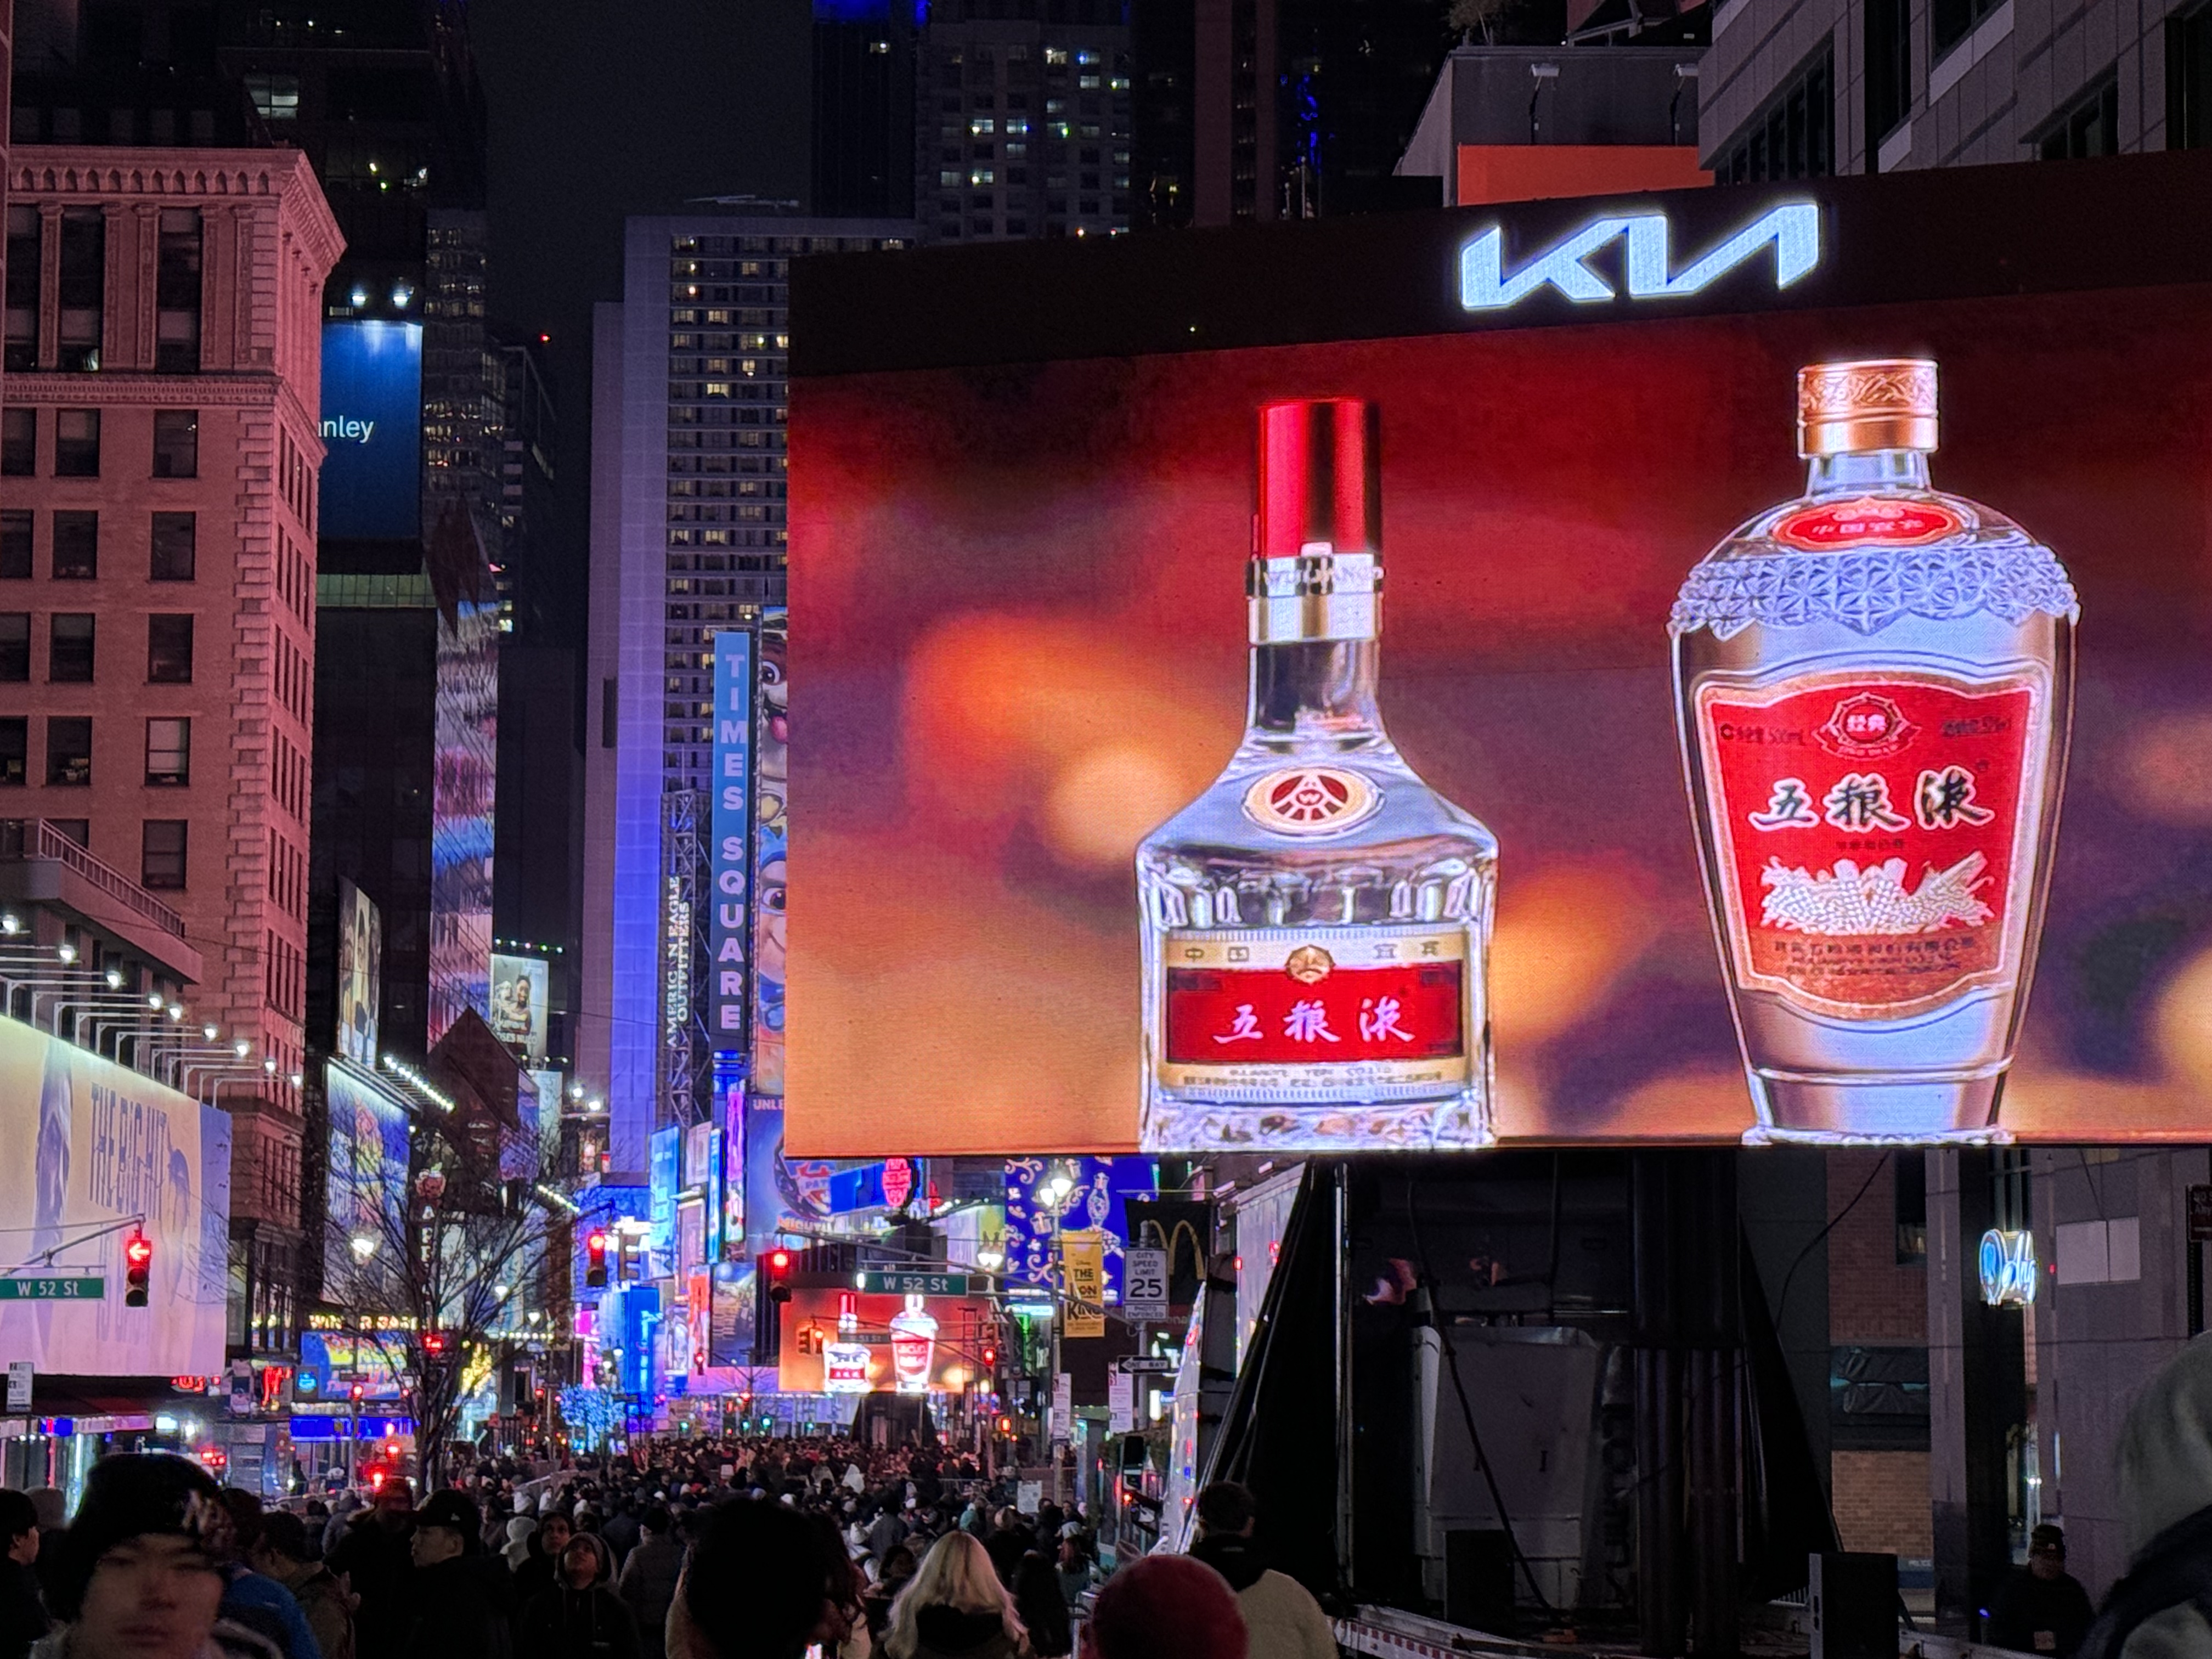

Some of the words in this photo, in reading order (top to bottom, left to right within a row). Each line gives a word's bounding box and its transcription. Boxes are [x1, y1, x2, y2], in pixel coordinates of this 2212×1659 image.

[1462, 204, 1819, 309] KIA
[719, 654, 747, 811] TIMES
[1748, 766, 1995, 831] 五粮液
[668, 876, 680, 938] EAGLE
[718, 835, 747, 1030] SQUARE
[677, 901, 690, 1022] OUTFITTERS
[667, 946, 678, 1048] AMERICN
[1212, 996, 1415, 1044] 五粮液
[17, 1283, 31, 1295] W
[38, 1282, 55, 1295] 52
[64, 1282, 79, 1295] St
[883, 1277, 897, 1289] W
[903, 1277, 924, 1290] 52
[930, 1278, 949, 1292] St
[1074, 1268, 1093, 1277] THE
[1130, 1279, 1163, 1297] 25
